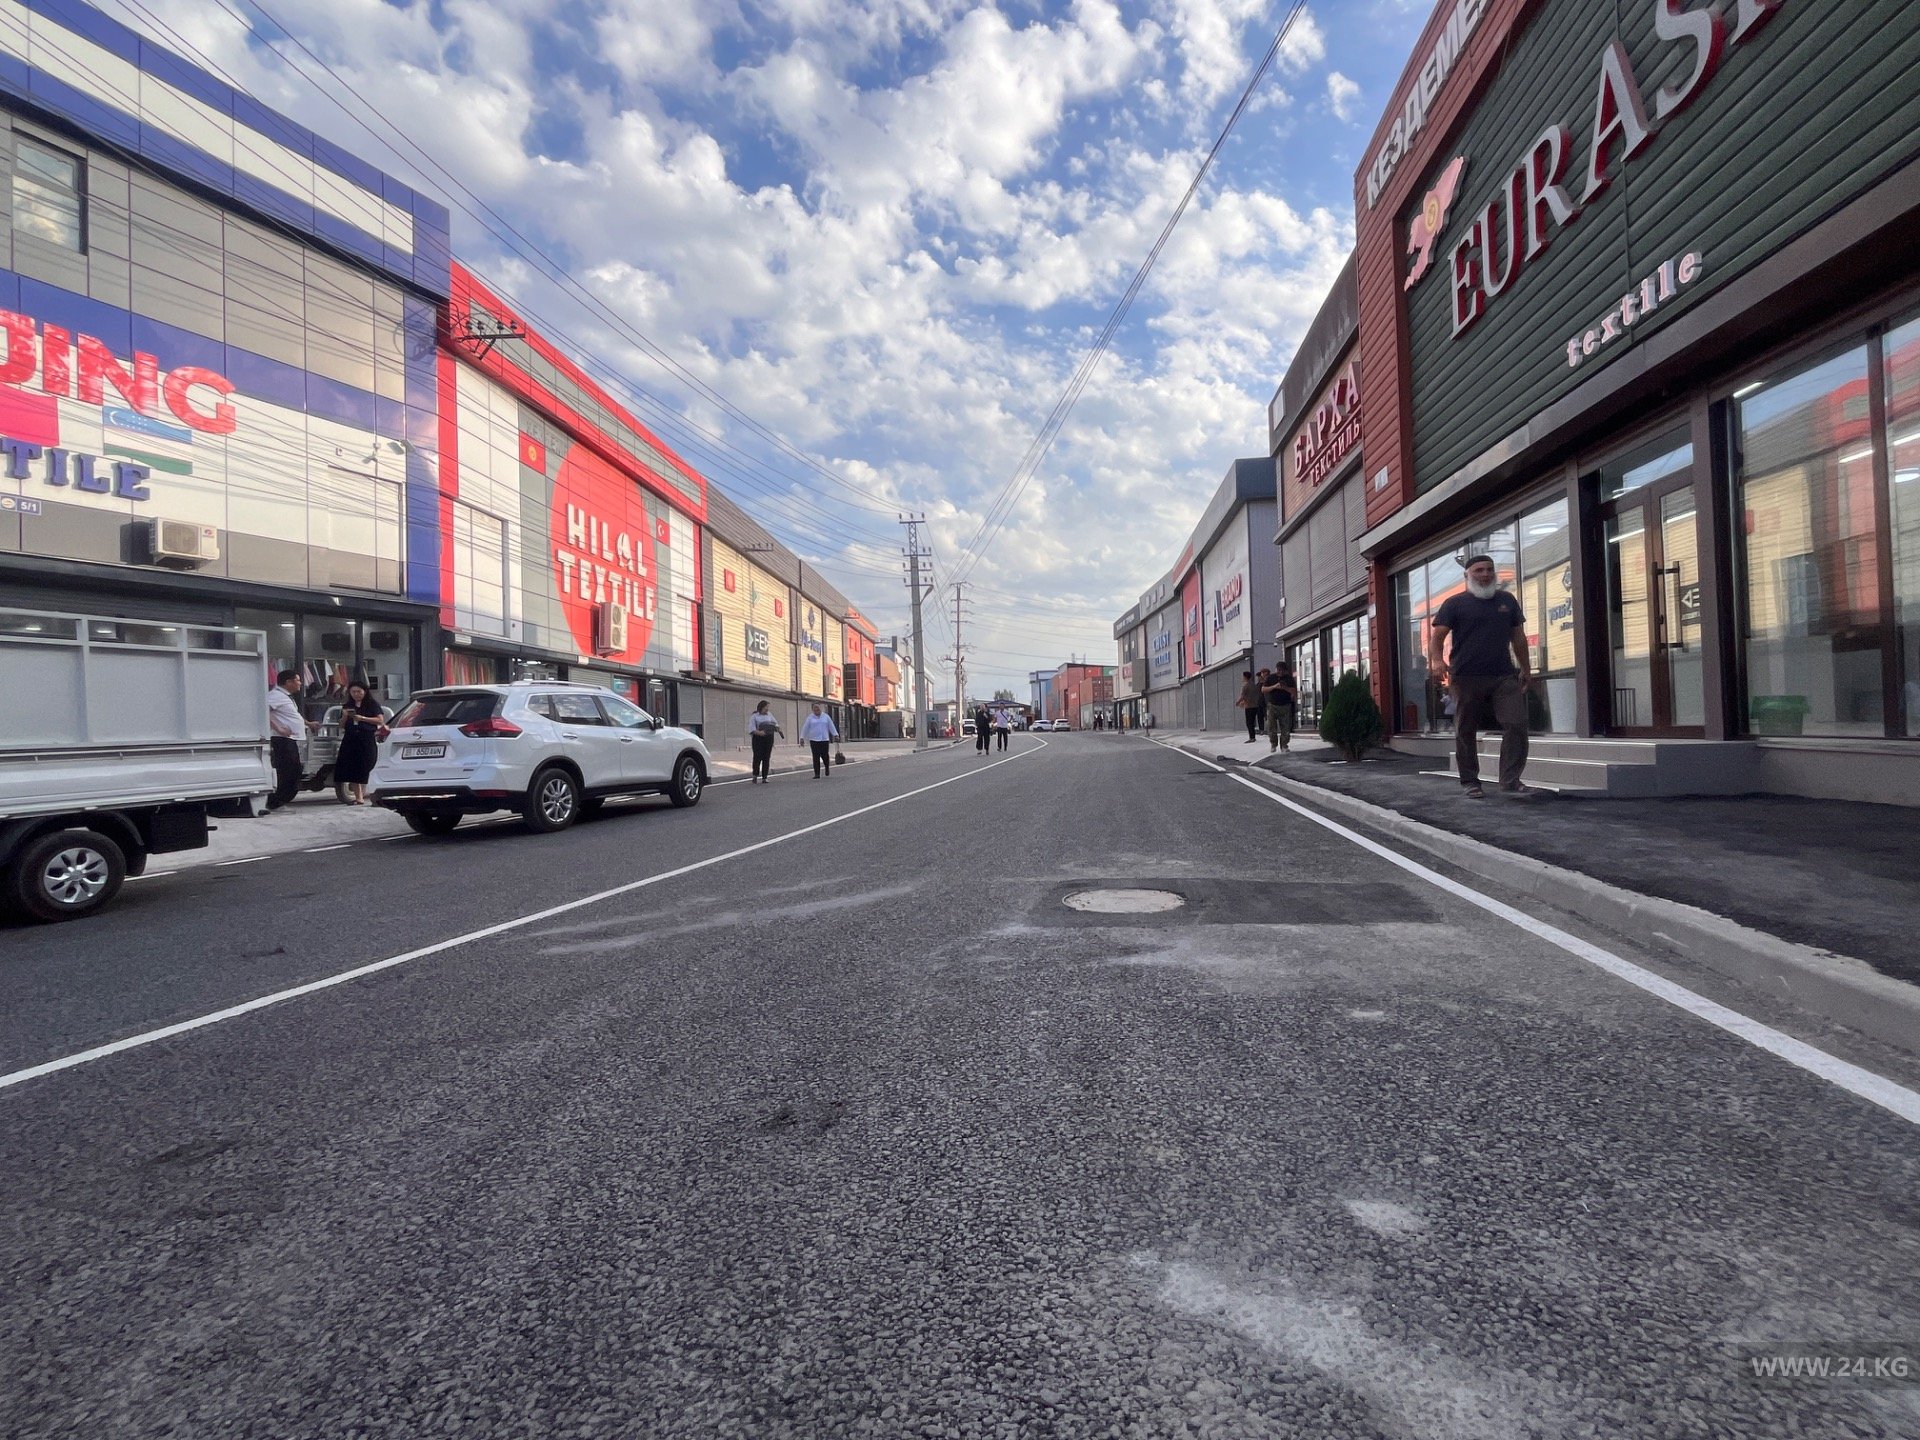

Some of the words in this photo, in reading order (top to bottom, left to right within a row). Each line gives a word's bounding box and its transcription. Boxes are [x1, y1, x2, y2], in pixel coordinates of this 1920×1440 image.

[1366, 0, 1490, 211] КЕЗДЕМЕ
[1447, 0, 1778, 340] EURAS
[1566, 250, 1702, 368] textile
[1310, 416, 1362, 487] ТЕКСТИЛЬ
[21, 501, 37, 512] 5/1
[556, 549, 655, 621] TEXTILE
